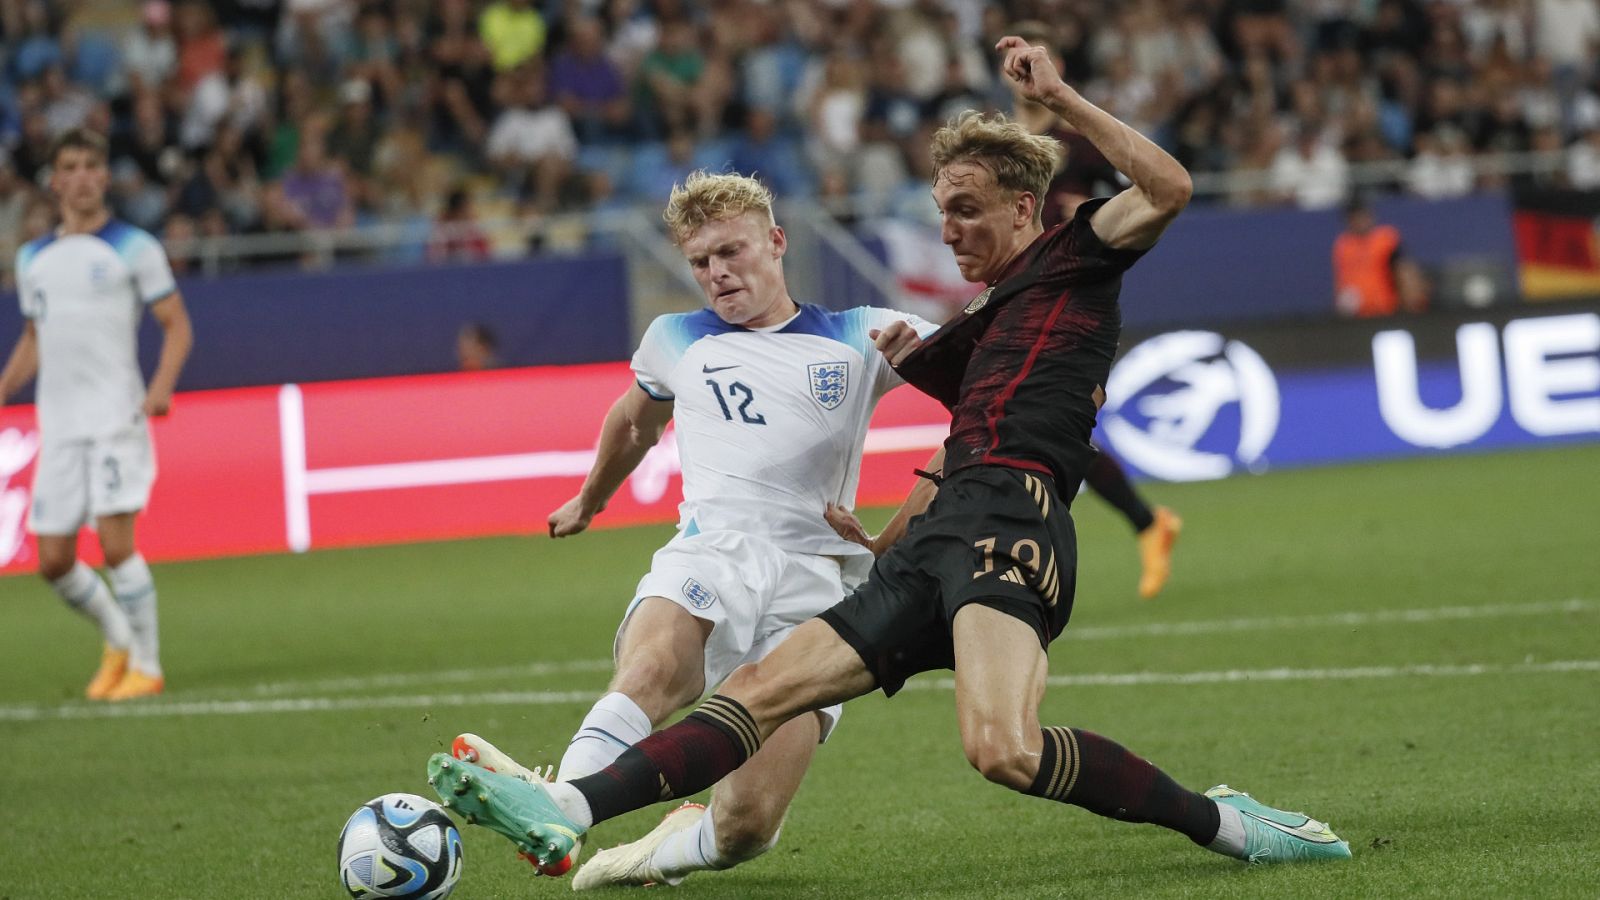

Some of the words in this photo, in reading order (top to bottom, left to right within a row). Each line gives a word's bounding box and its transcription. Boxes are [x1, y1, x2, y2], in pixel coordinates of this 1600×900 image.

[705, 379, 767, 425] 12
[1372, 313, 1600, 448] UE
[102, 456, 121, 490] 3
[973, 537, 1040, 579] 19
